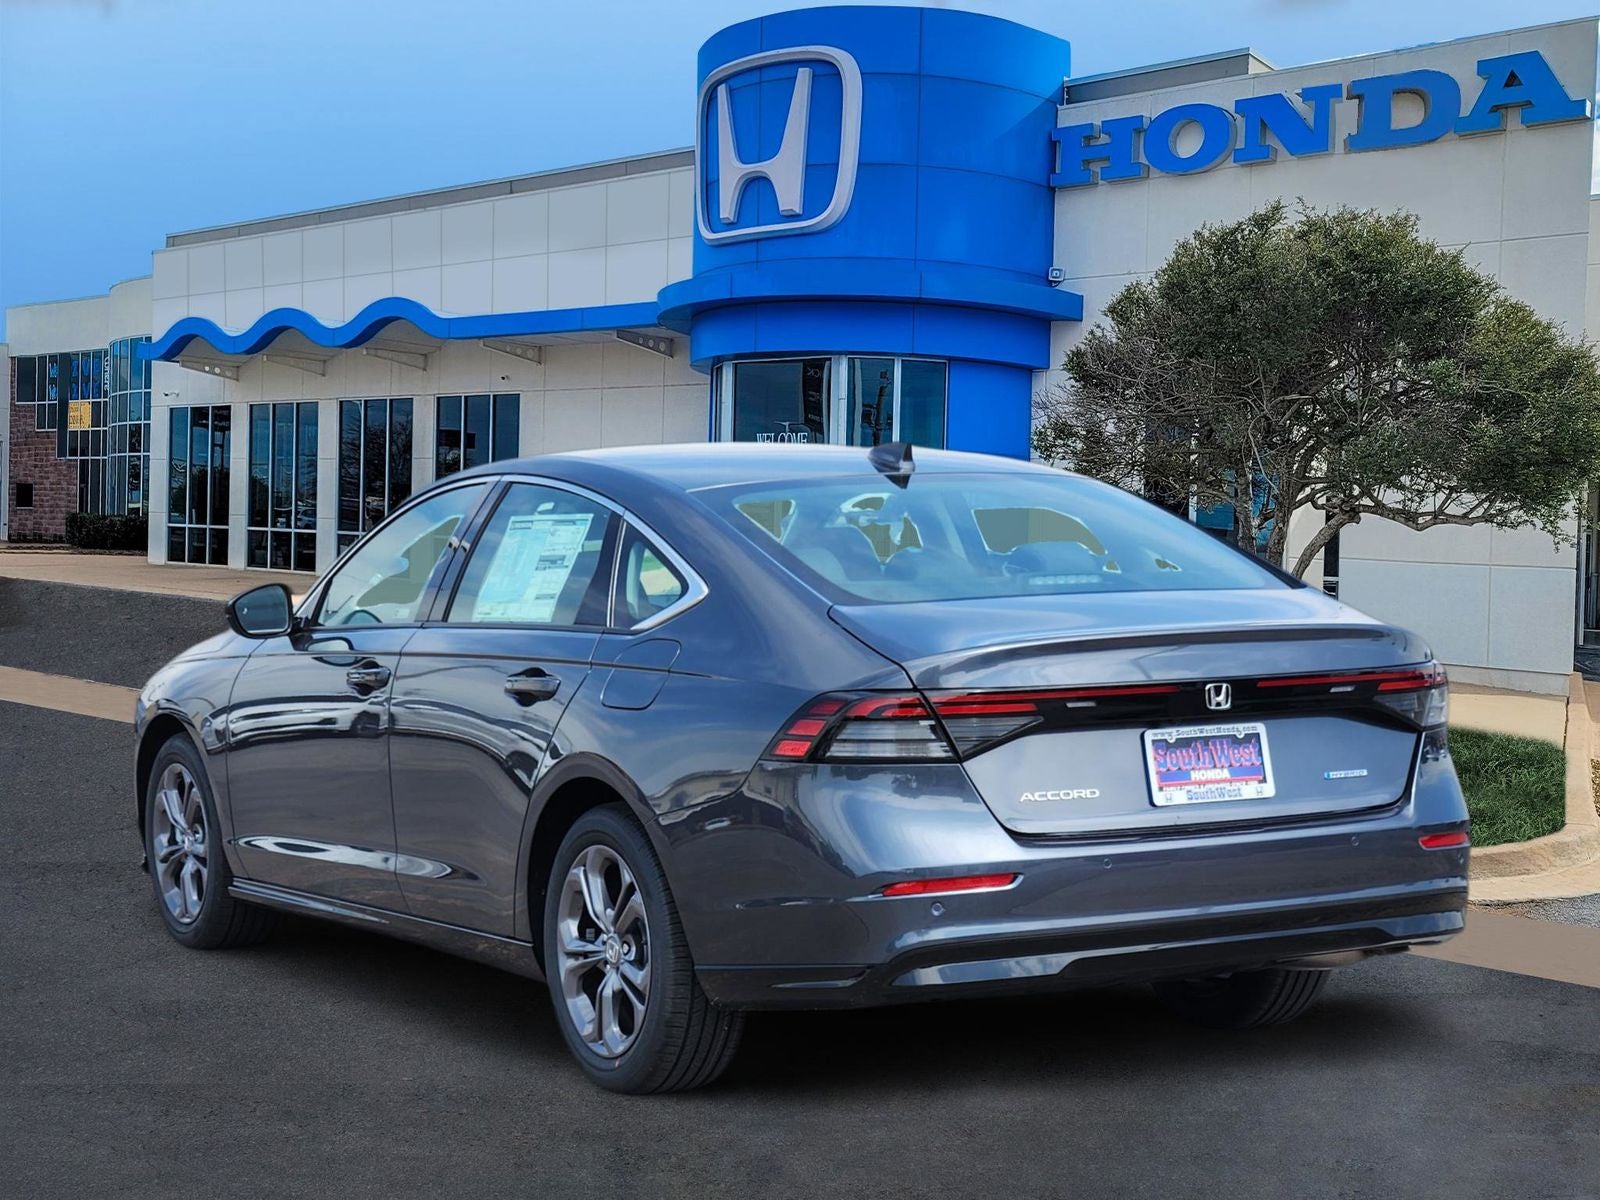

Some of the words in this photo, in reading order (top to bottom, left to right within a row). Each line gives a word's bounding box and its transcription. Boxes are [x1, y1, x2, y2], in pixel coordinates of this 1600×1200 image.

[1050, 50, 1591, 187] HONDA
[1152, 737, 1262, 772] SouthWest
[1190, 768, 1231, 780] HONDA
[1019, 788, 1100, 802] ACCORD
[1186, 786, 1243, 801] SouthWest
